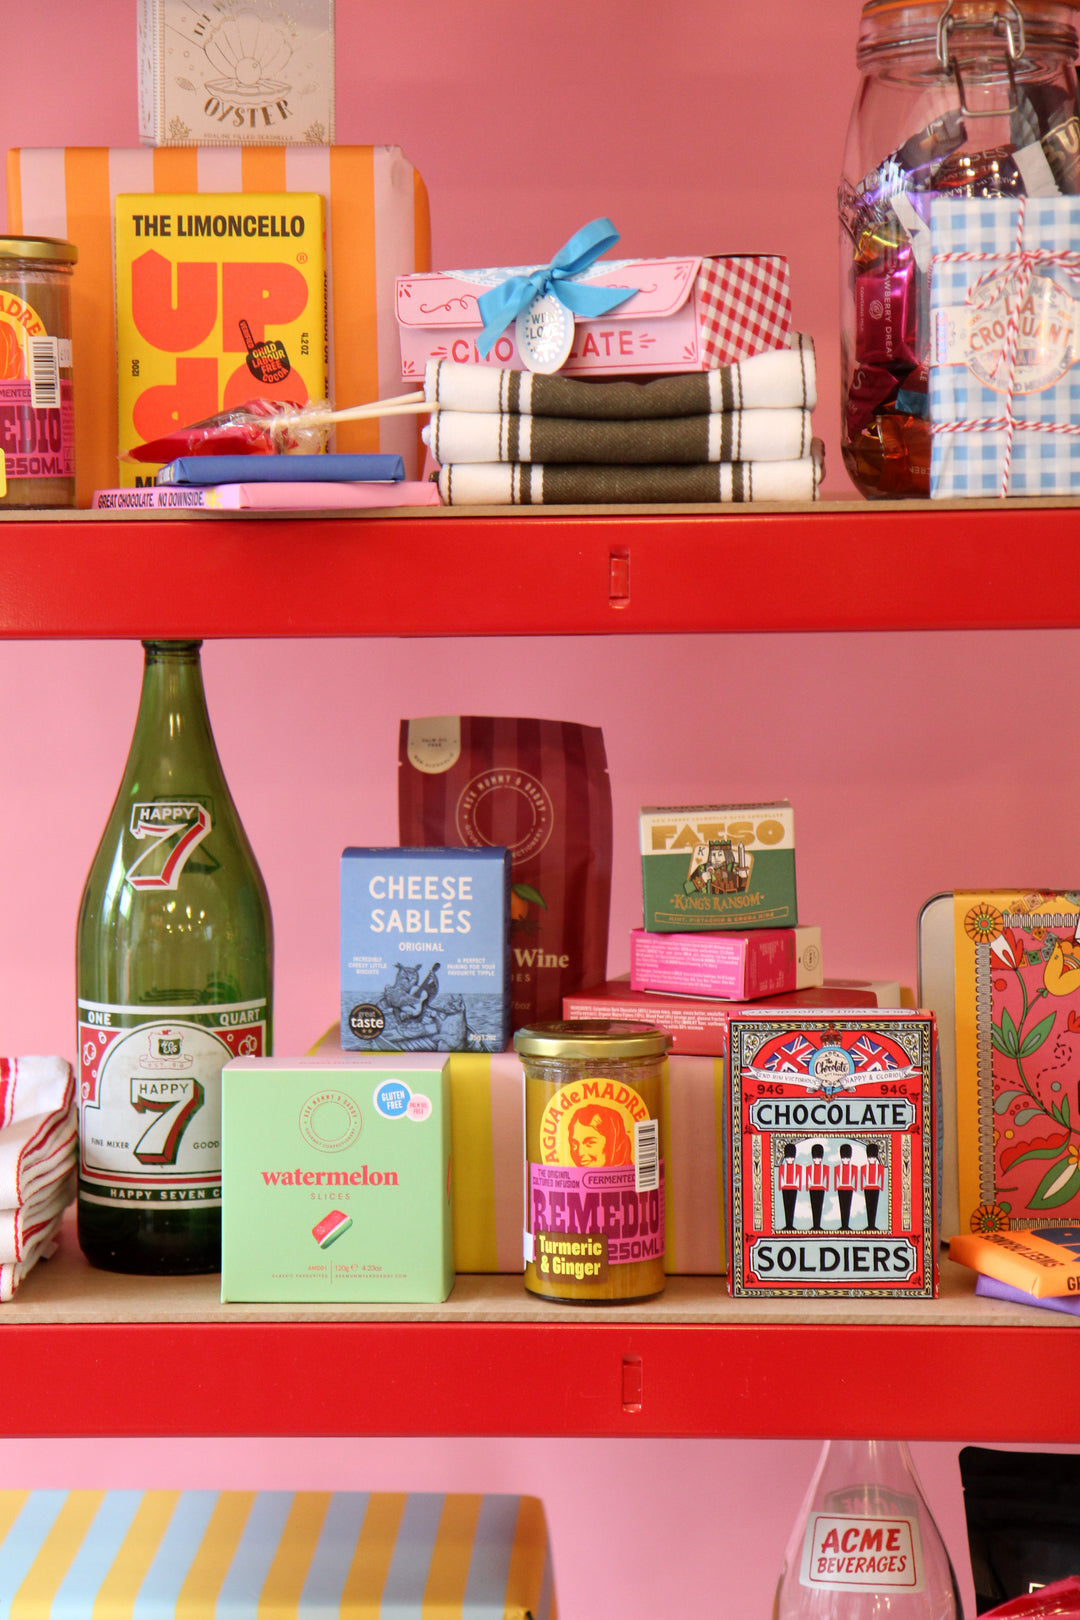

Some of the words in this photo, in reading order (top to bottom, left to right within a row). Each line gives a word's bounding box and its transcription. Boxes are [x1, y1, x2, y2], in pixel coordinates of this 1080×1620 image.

[204, 97, 293, 128] OYSTER
[132, 216, 171, 237] THE
[178, 215, 305, 237] LIMONCELLO
[132, 248, 308, 353] UP
[1005, 296, 1034, 316] LA
[252, 343, 277, 358] CHILD
[252, 349, 286, 368] LABOUR
[261, 360, 282, 373] FREE
[262, 368, 288, 382] COCOA
[4, 456, 63, 475] 250ML
[98, 494, 118, 508] GREAT
[118, 492, 154, 508] CHOCOLATE.
[158, 492, 168, 507] NO
[168, 492, 204, 506] DOWNSIDE.
[464, 790, 476, 809] ASK
[478, 775, 510, 791] MUMMY
[524, 782, 546, 812] DADDY
[140, 808, 195, 820] HAPPY
[651, 820, 784, 850] FATSO
[125, 802, 212, 891] 7
[698, 846, 706, 856] K
[369, 876, 472, 900] CHEESE
[674, 894, 711, 911] KING'S
[712, 892, 760, 912] RANSOM
[370, 902, 472, 934] SABLÉS
[399, 942, 444, 952] ORIGINAL
[514, 948, 570, 968] Wine
[88, 1010, 112, 1026] ONE
[220, 1008, 260, 1026] QUART
[351, 1018, 384, 1028] taste
[816, 1061, 848, 1074] Chocolate
[845, 1074, 866, 1084] HAPPY
[140, 1083, 189, 1094] HAPPY
[382, 1090, 406, 1102] GLUTEN
[757, 1084, 784, 1096] 94G
[880, 1084, 908, 1096] 94G
[386, 1100, 402, 1110] FREE
[130, 1078, 204, 1165] 7
[544, 1107, 564, 1164] AGUA
[560, 1091, 582, 1112] de
[582, 1082, 646, 1122] MADRE
[756, 1104, 906, 1126] CHOCOLATE
[91, 1137, 104, 1147] FINE
[106, 1138, 129, 1149] MIXER
[193, 1140, 220, 1150] GOOD
[260, 1164, 399, 1186] watermelon
[532, 1176, 554, 1188] CULTURED
[555, 1178, 580, 1188] INFUSION
[538, 1168, 546, 1178] THE
[547, 1169, 570, 1180] ORIGINAL
[588, 1174, 636, 1184] FERMENTED
[110, 1189, 152, 1200] HAPPY
[160, 1190, 206, 1200] SEVEN
[310, 1192, 351, 1200] SLICES
[533, 1188, 660, 1239] REMEDIO
[540, 1236, 602, 1256] Turmeric
[608, 1242, 660, 1261] 250ML
[540, 1255, 550, 1274] &
[552, 1256, 601, 1280] Ginger
[757, 1246, 910, 1273] SOLDIERS
[820, 1528, 901, 1554] ACME
[816, 1555, 907, 1574] BEVERAGES
